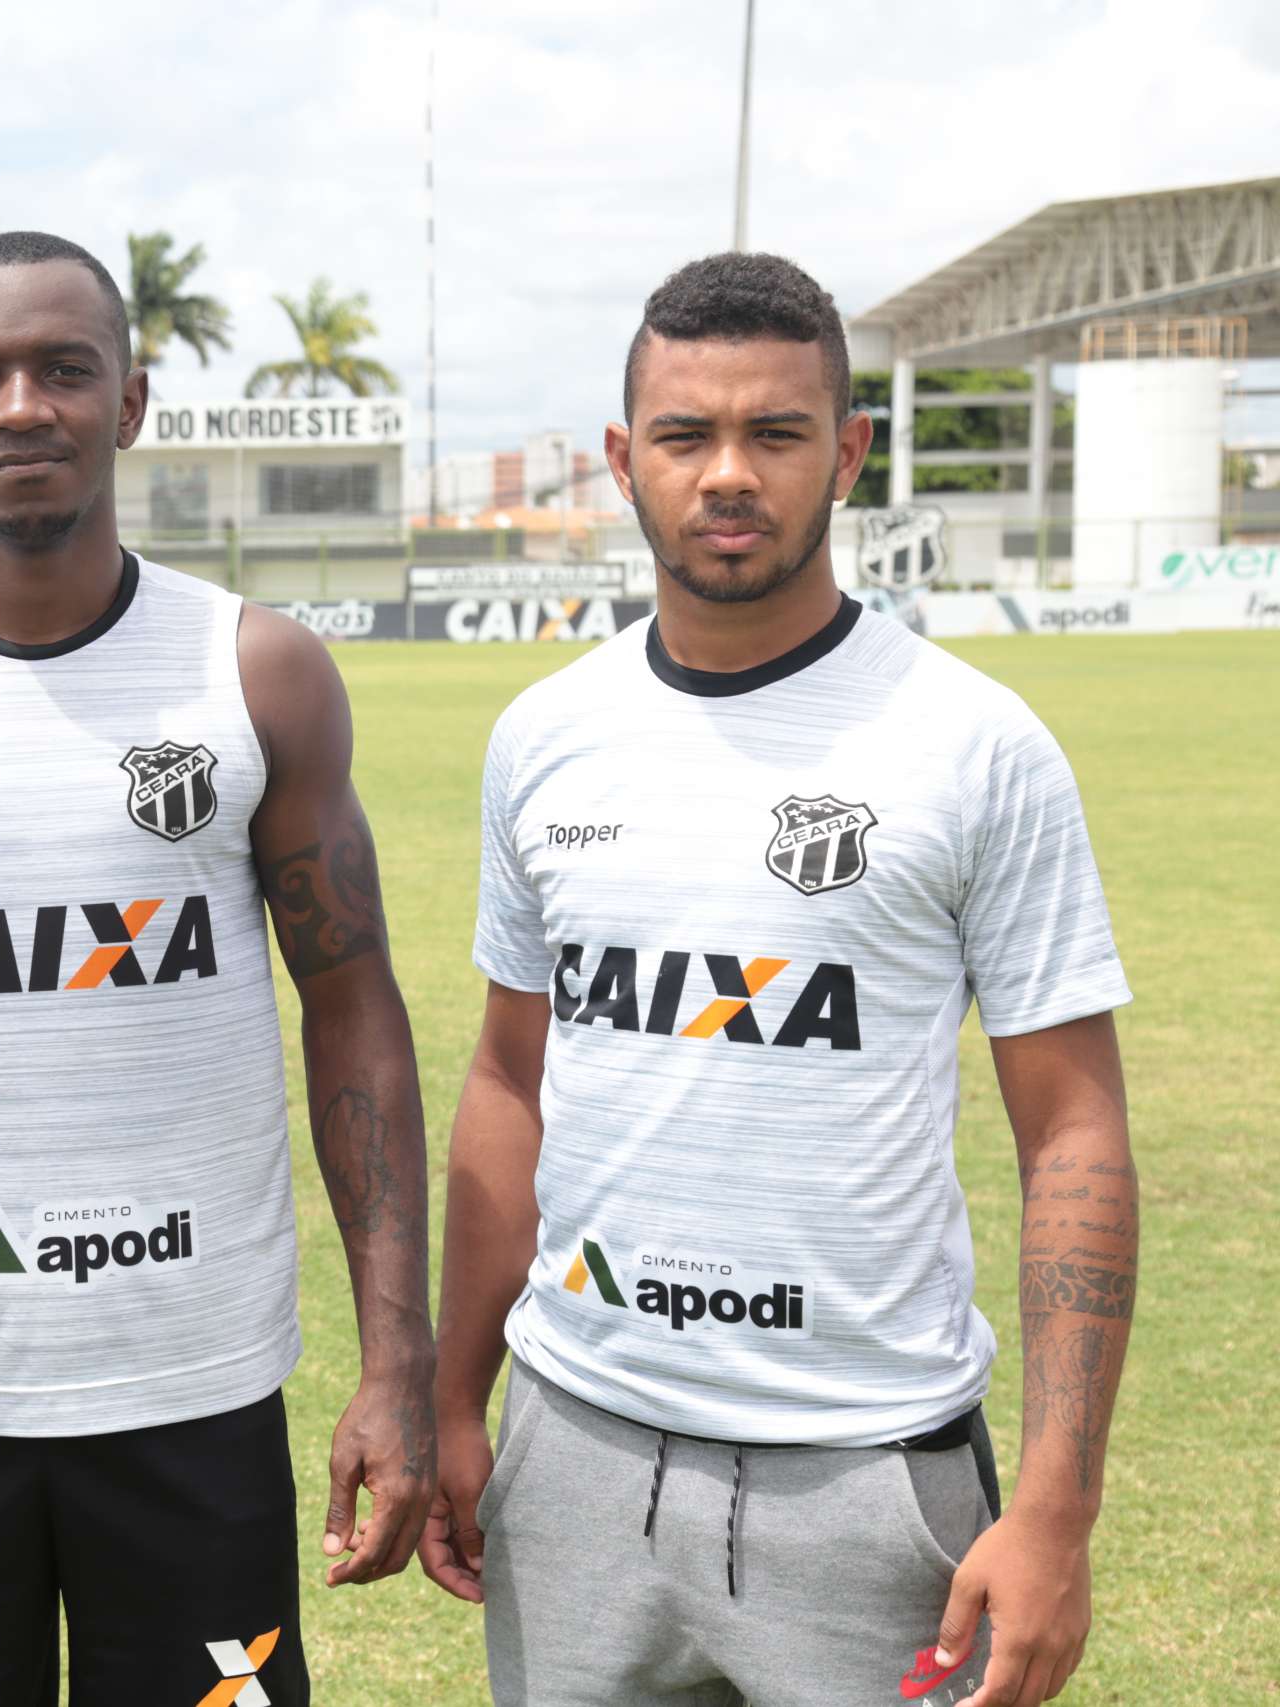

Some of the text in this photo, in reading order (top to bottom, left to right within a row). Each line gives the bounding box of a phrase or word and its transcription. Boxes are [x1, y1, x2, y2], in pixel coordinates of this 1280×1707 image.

[157, 409, 194, 440] DO
[206, 407, 360, 439] NORDESTE
[445, 598, 618, 642] CAIXA
[1039, 601, 1129, 633] apodi
[546, 823, 623, 849] Topper
[553, 943, 862, 1051] CAIXA
[44, 1206, 131, 1222] CIMENTO
[37, 1210, 192, 1283] apodi
[642, 1254, 732, 1275] CIMENTO
[636, 1278, 803, 1331] apodi
